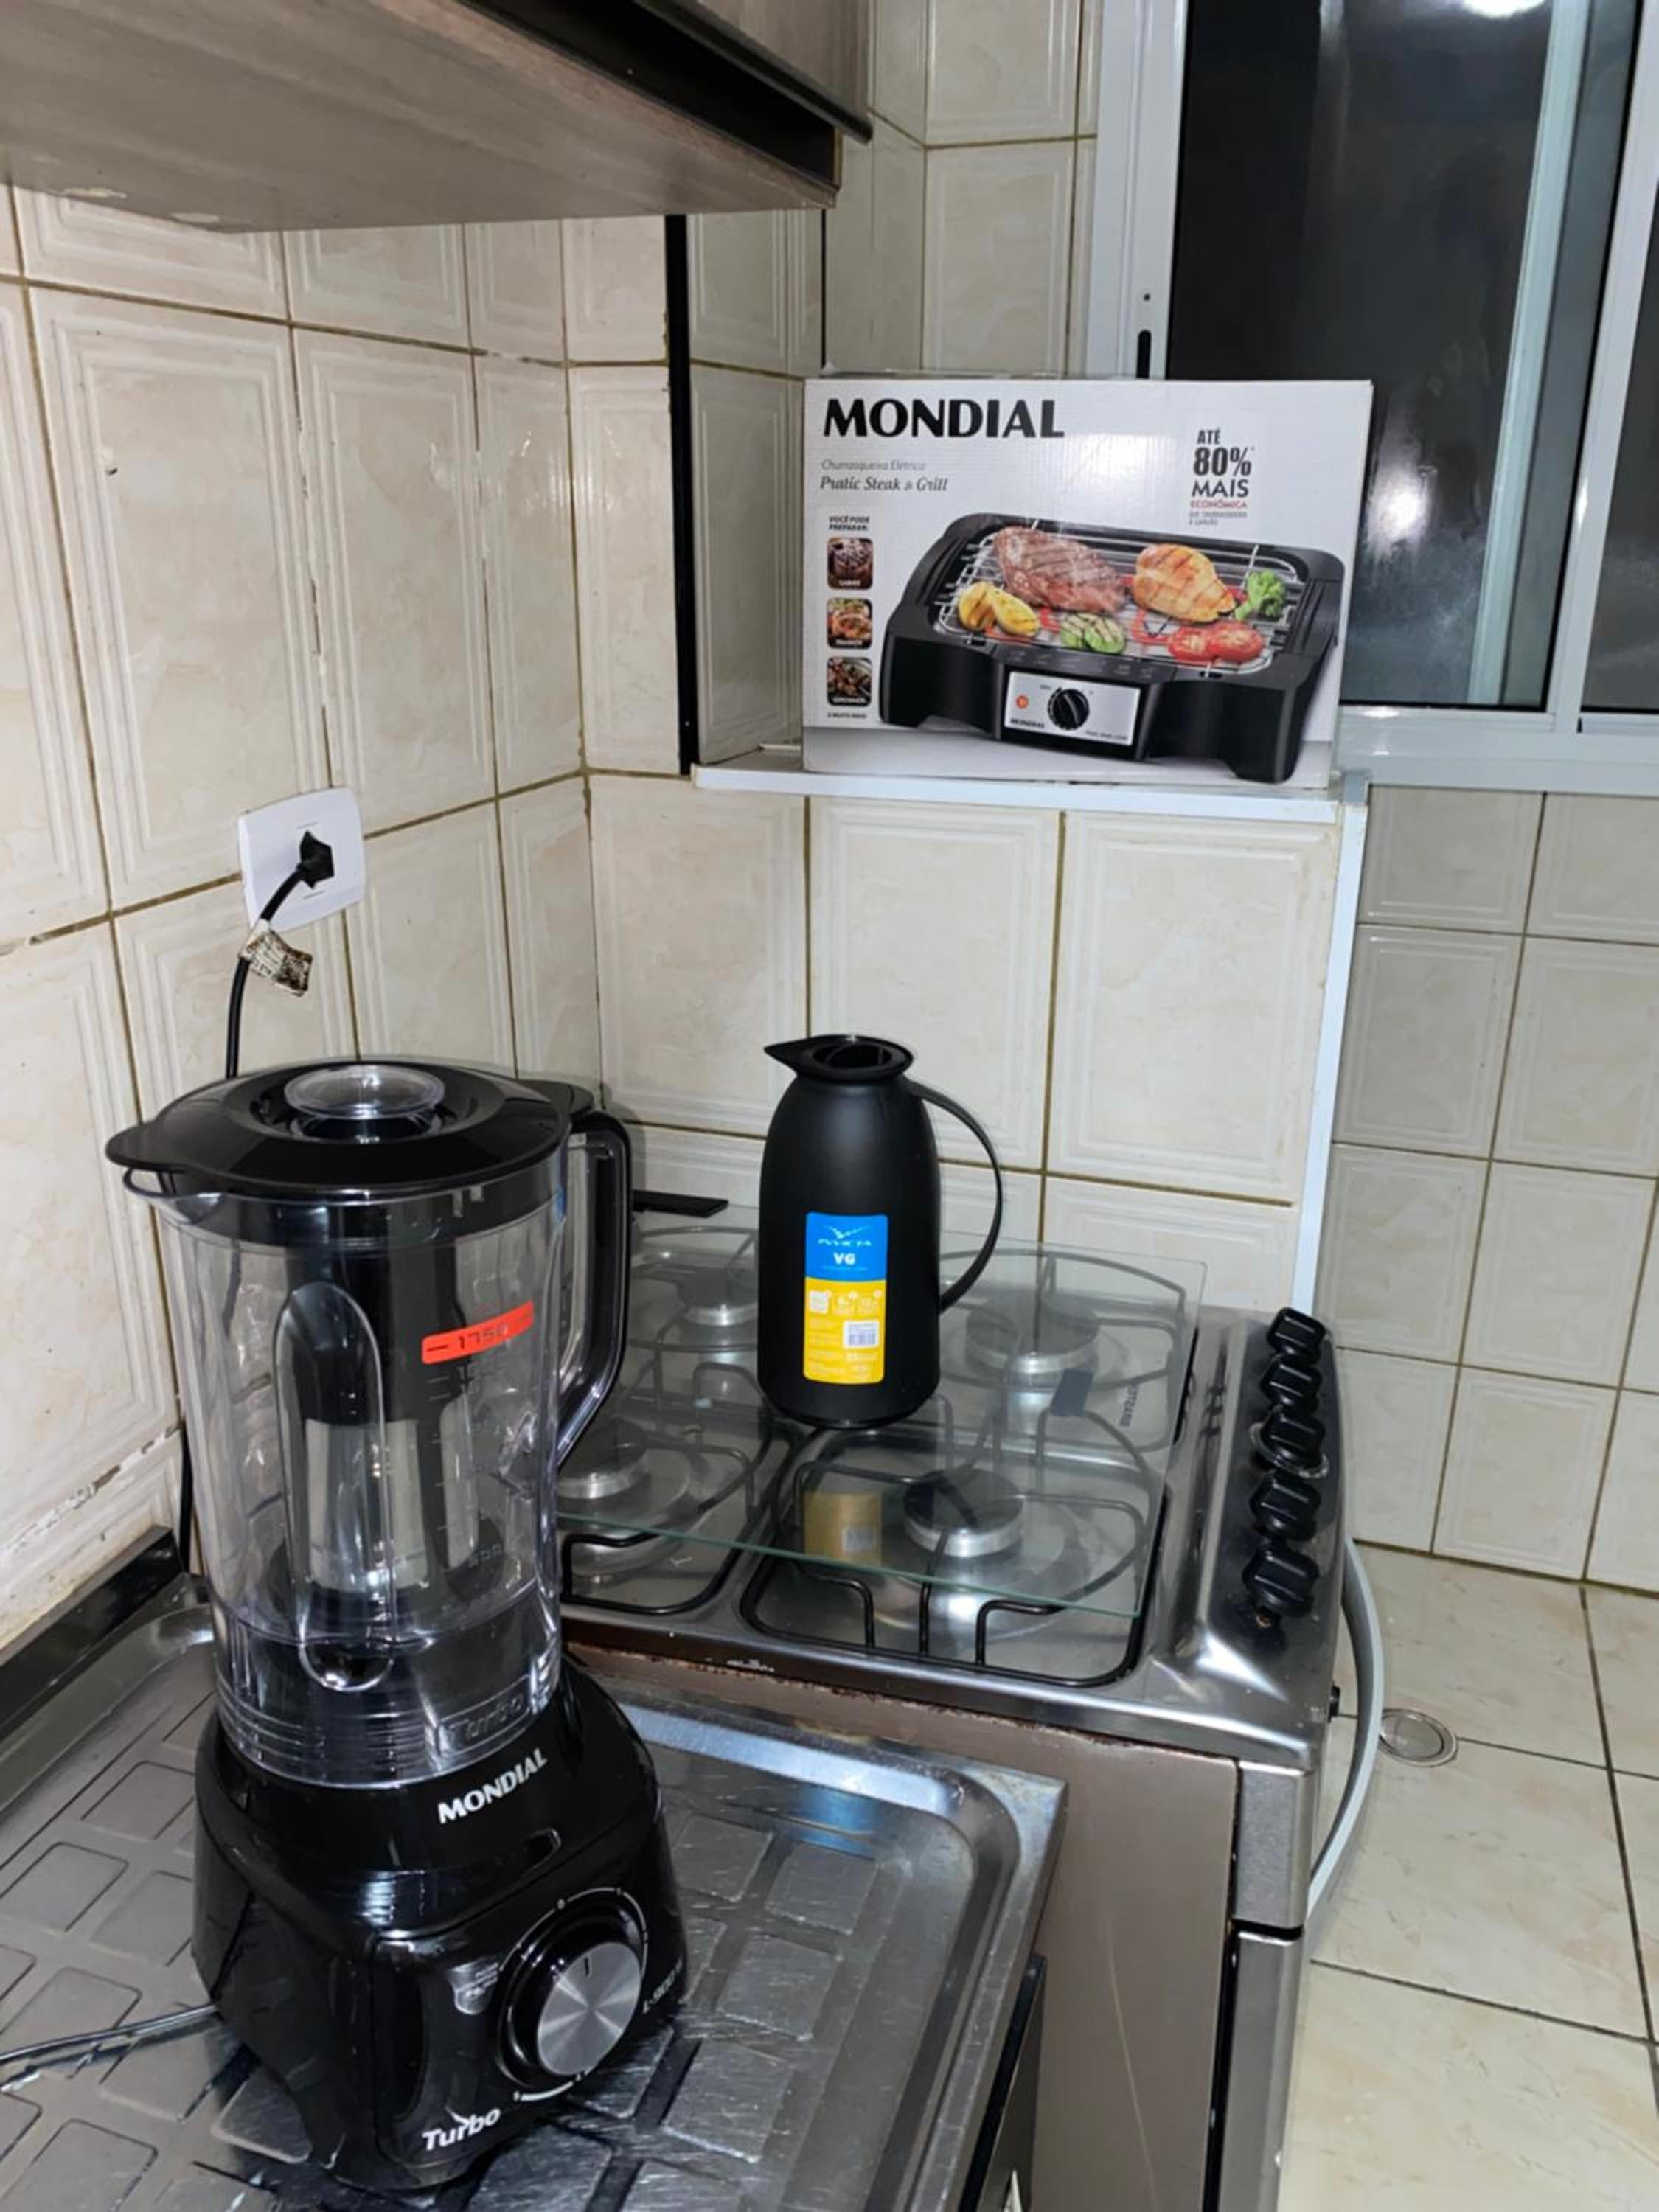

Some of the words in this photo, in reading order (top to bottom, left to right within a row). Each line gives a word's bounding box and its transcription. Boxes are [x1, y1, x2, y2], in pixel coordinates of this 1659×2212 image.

[823, 398, 1065, 438] MONDIAL
[1197, 427, 1220, 444] ATÉ
[863, 476, 901, 491] Steak
[916, 477, 948, 491] Grill
[1192, 479, 1249, 498] MAIS
[437, 1747, 548, 1825] MONDIAL
[422, 2107, 501, 2151] Turbo
